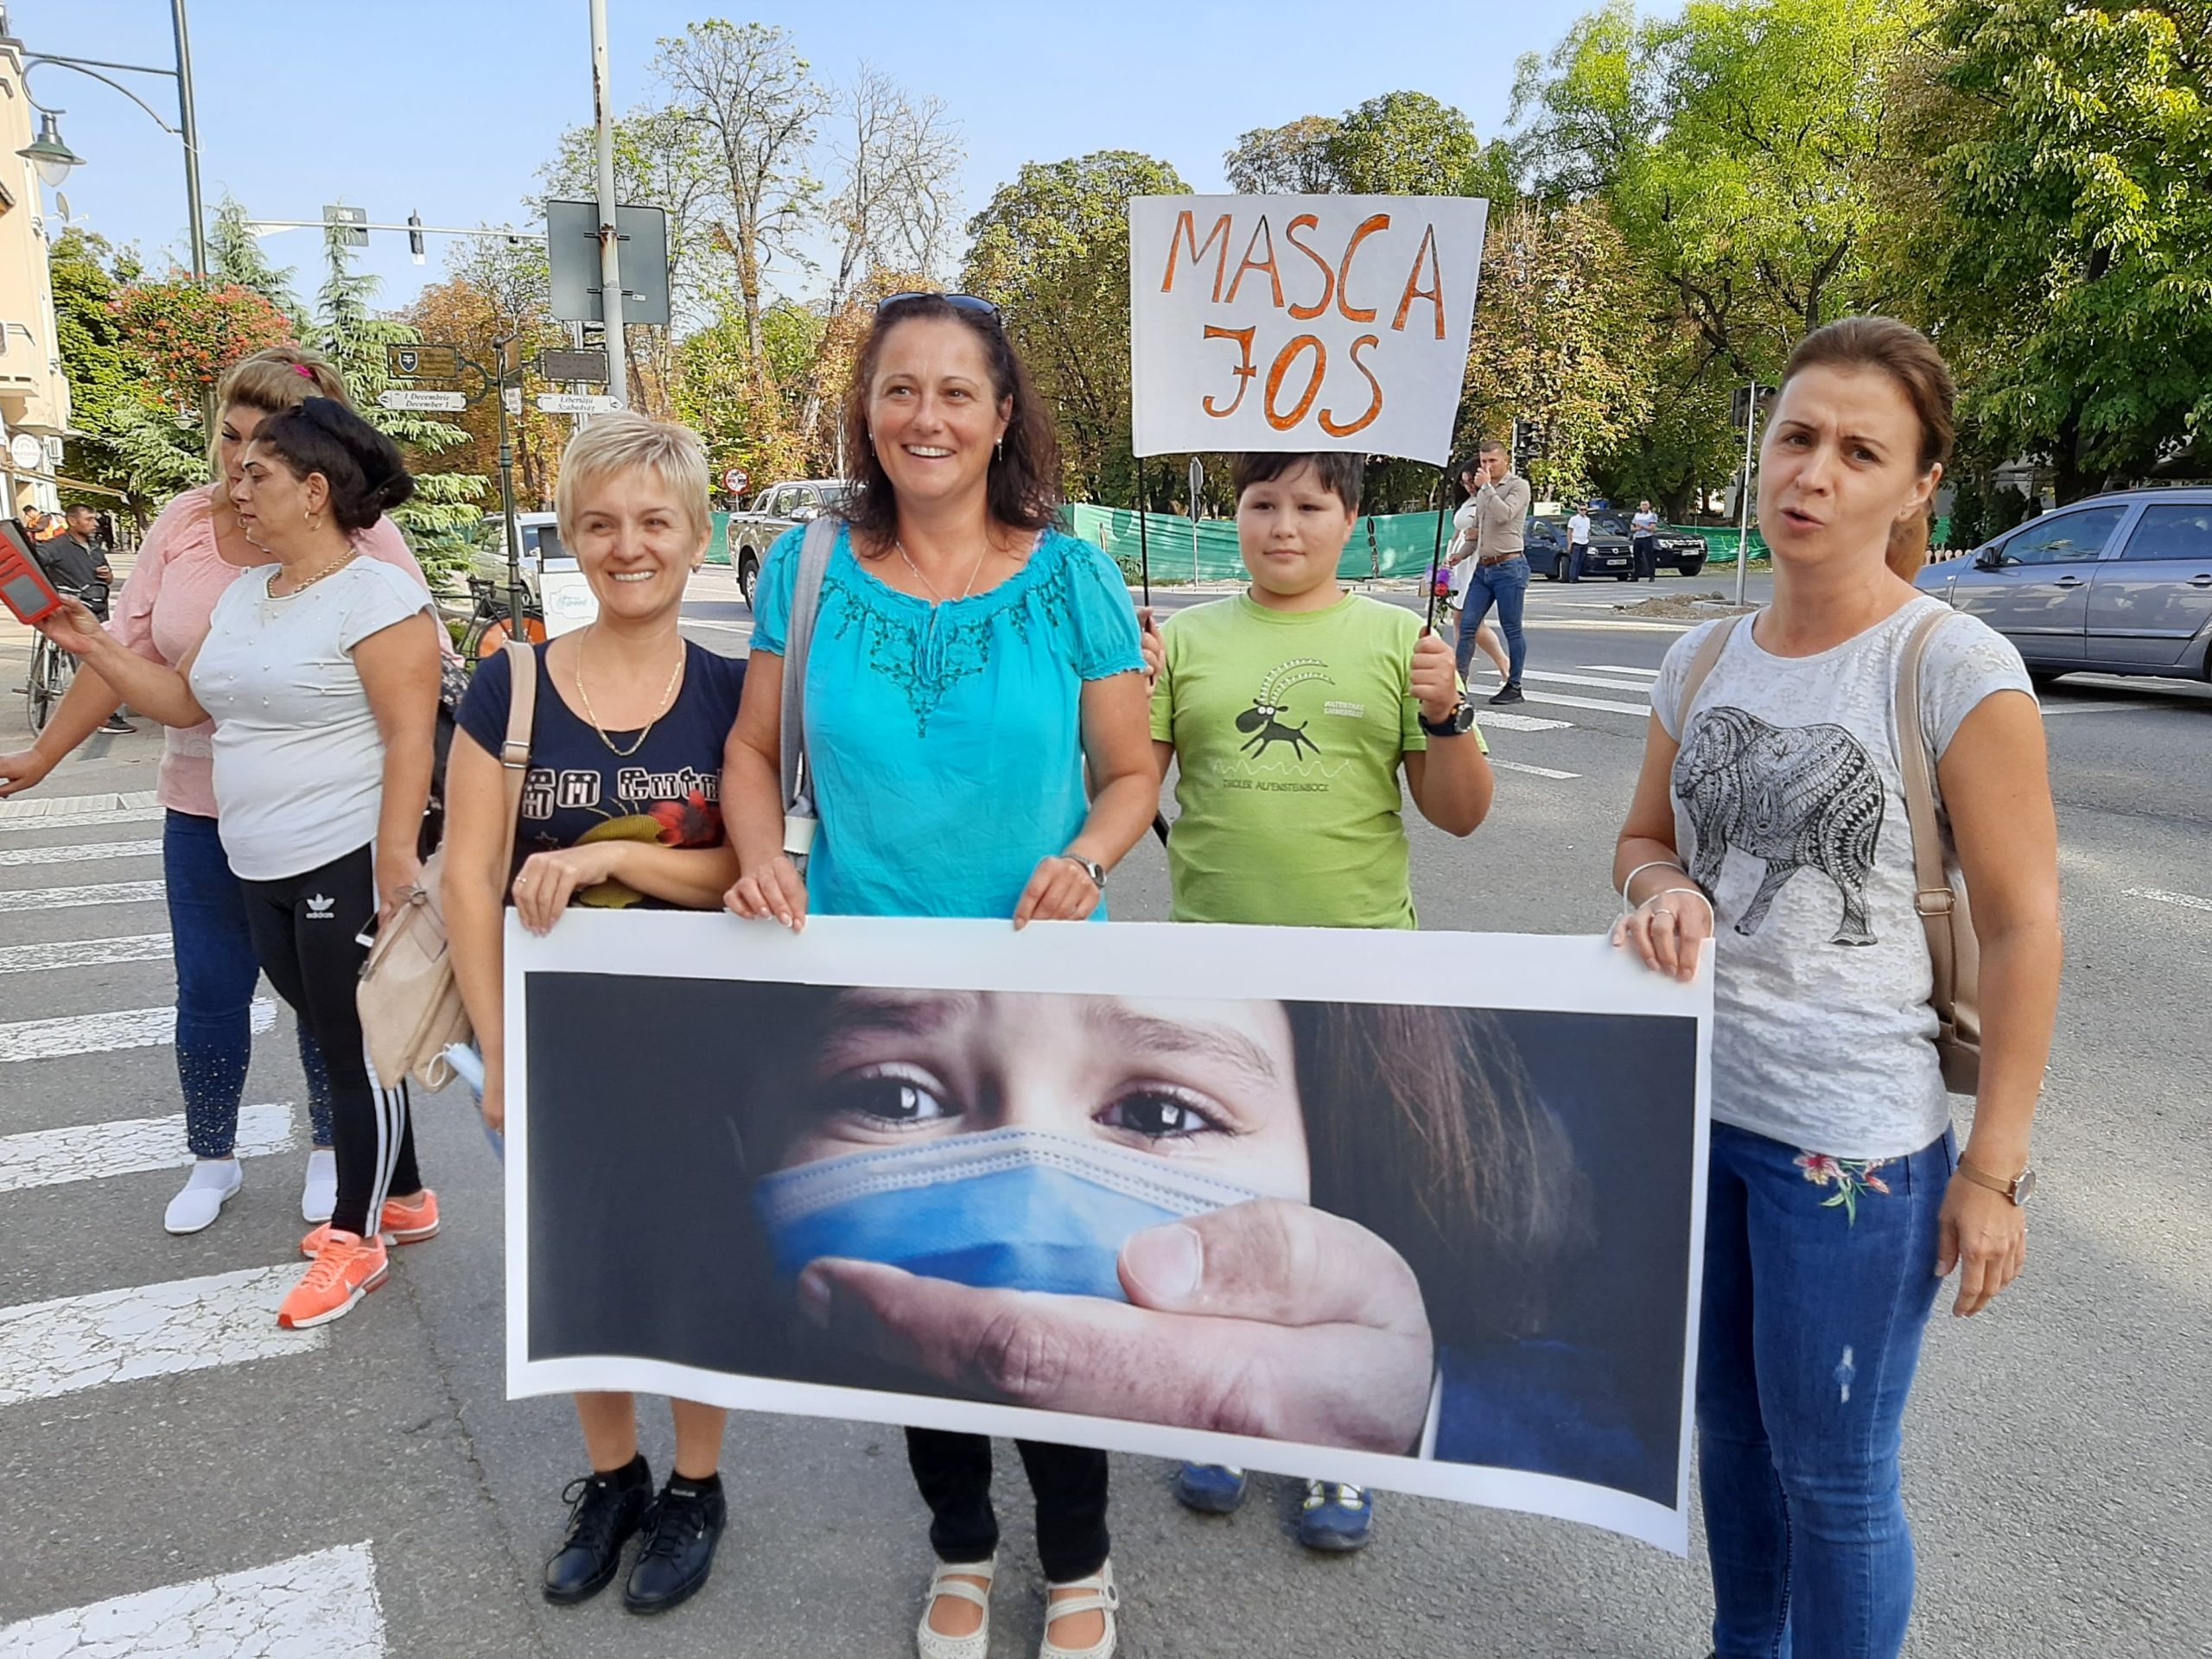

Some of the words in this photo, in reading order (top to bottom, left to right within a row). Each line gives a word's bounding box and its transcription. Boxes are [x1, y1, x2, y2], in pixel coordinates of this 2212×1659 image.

[1160, 210, 1446, 340] MASCA
[1202, 324, 1382, 438] JOS
[617, 766, 721, 802] Cute
